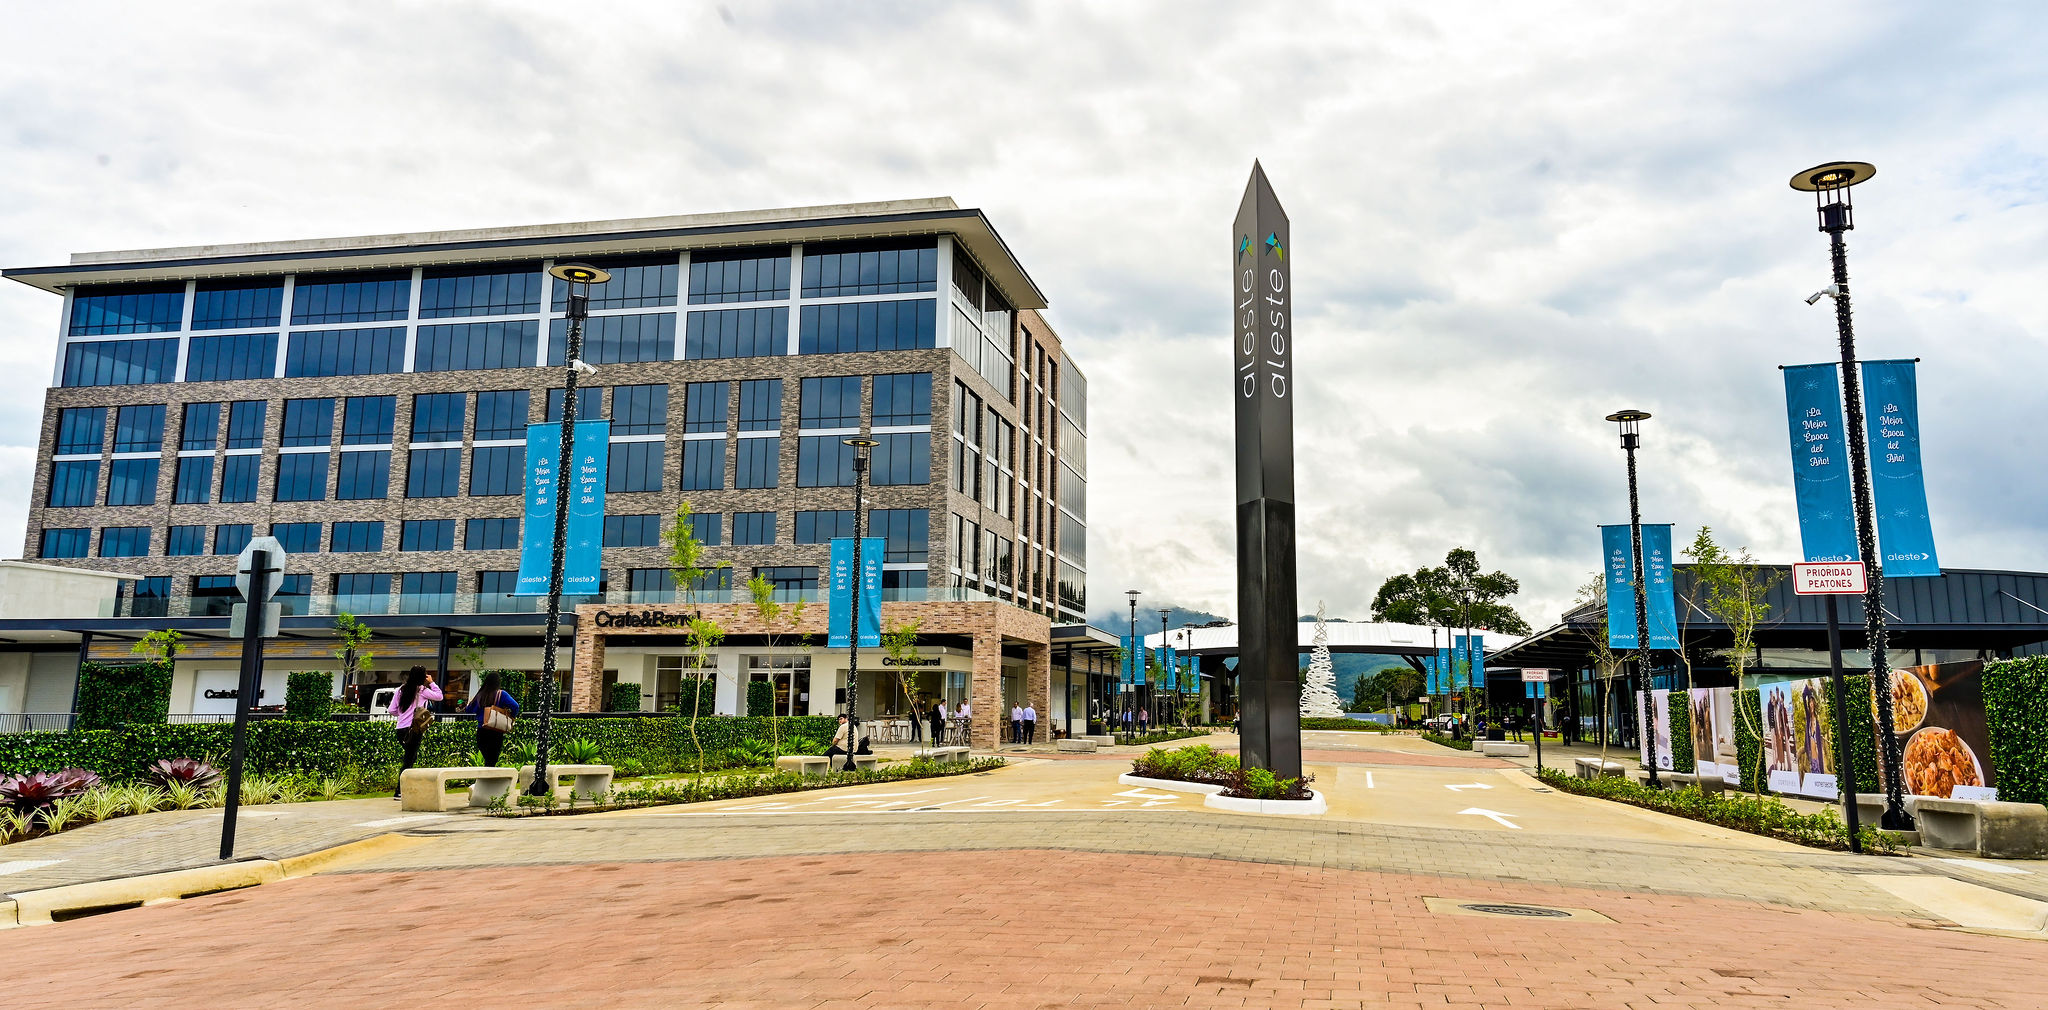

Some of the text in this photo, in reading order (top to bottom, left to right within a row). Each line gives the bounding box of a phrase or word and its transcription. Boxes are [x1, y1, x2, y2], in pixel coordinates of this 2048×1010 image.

[1239, 268, 1255, 398] aleste
[1265, 268, 1286, 398] aleste
[1806, 407, 1821, 417] ¡La
[1883, 403, 1898, 413] ¡La
[1802, 420, 1828, 430] Mejor
[1879, 416, 1904, 426] Mejor
[1803, 430, 1829, 442] Época
[1880, 427, 1905, 438] Época
[1810, 444, 1824, 453] del
[1887, 441, 1900, 450] del
[1809, 457, 1830, 467] Año!
[1886, 454, 1905, 463] Año!
[535, 467, 550, 475] Mejor
[580, 466, 597, 474] Mejor
[1810, 554, 1844, 562] aleste
[1887, 553, 1920, 561] aleste
[1806, 568, 1853, 577] PRIORIDAD
[1808, 579, 1853, 588] PEATONES
